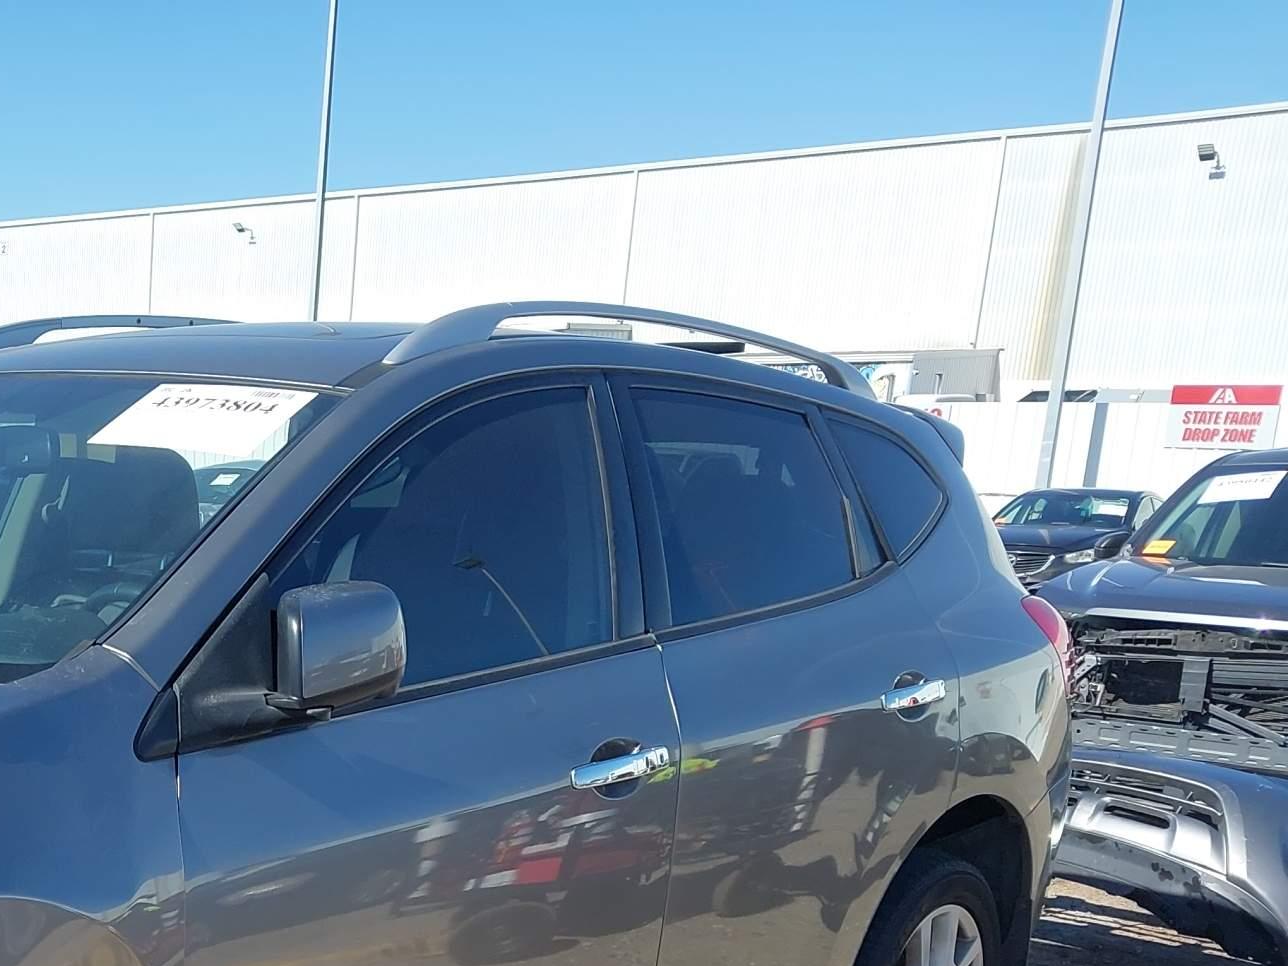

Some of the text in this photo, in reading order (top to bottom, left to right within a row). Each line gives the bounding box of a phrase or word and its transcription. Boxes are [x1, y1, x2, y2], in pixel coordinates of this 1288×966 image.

[152, 396, 278, 414] 43973804
[1182, 410, 1262, 424] STATE FARM
[1182, 427, 1256, 442] DROP ZONE
